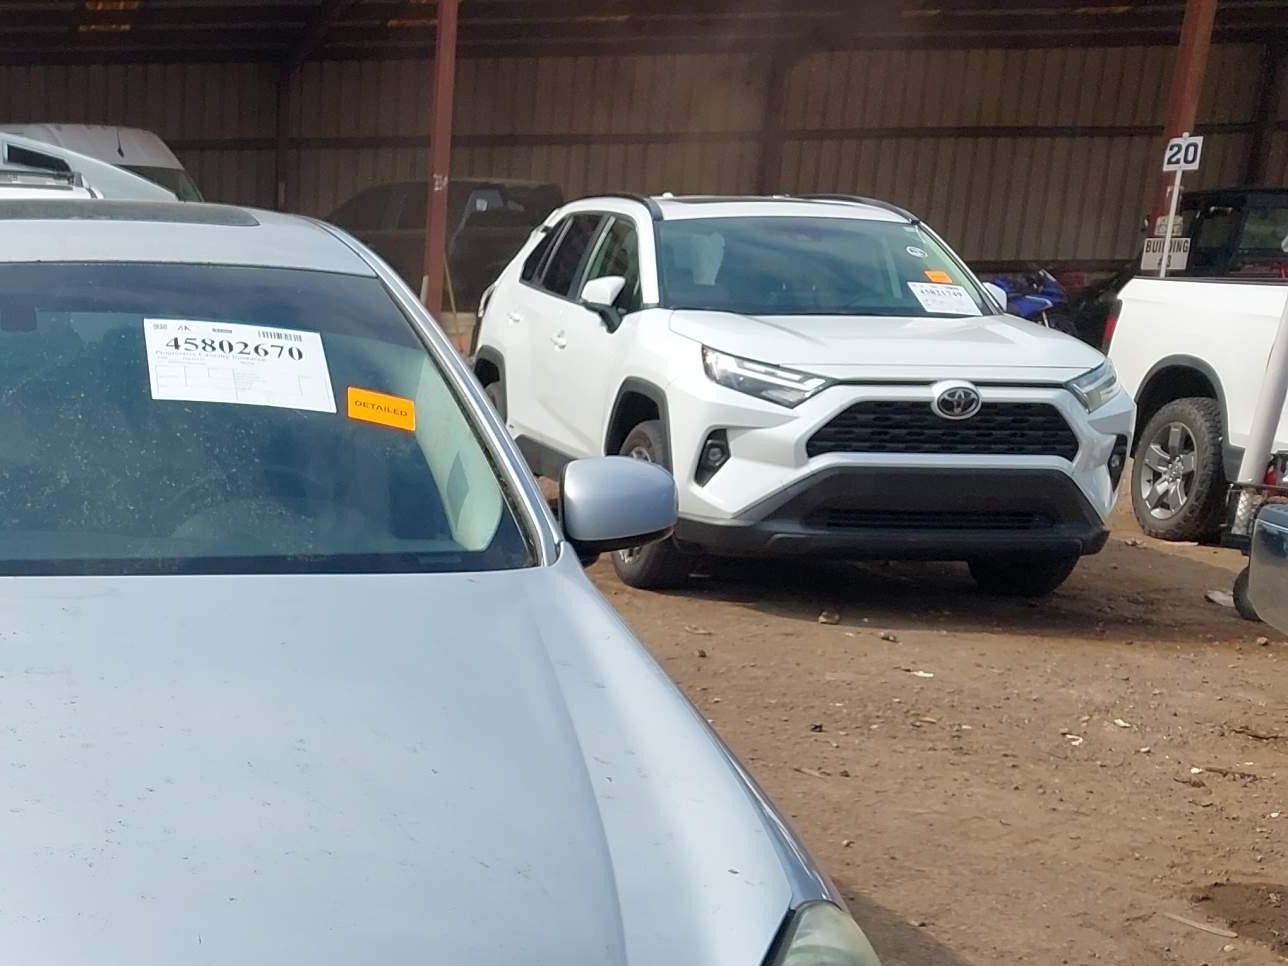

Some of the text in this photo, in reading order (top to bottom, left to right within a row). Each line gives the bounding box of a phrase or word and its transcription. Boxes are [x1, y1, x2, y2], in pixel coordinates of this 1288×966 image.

[1166, 142, 1199, 165] 20
[165, 336, 304, 361] 45802670
[354, 400, 408, 416] DETAILED
